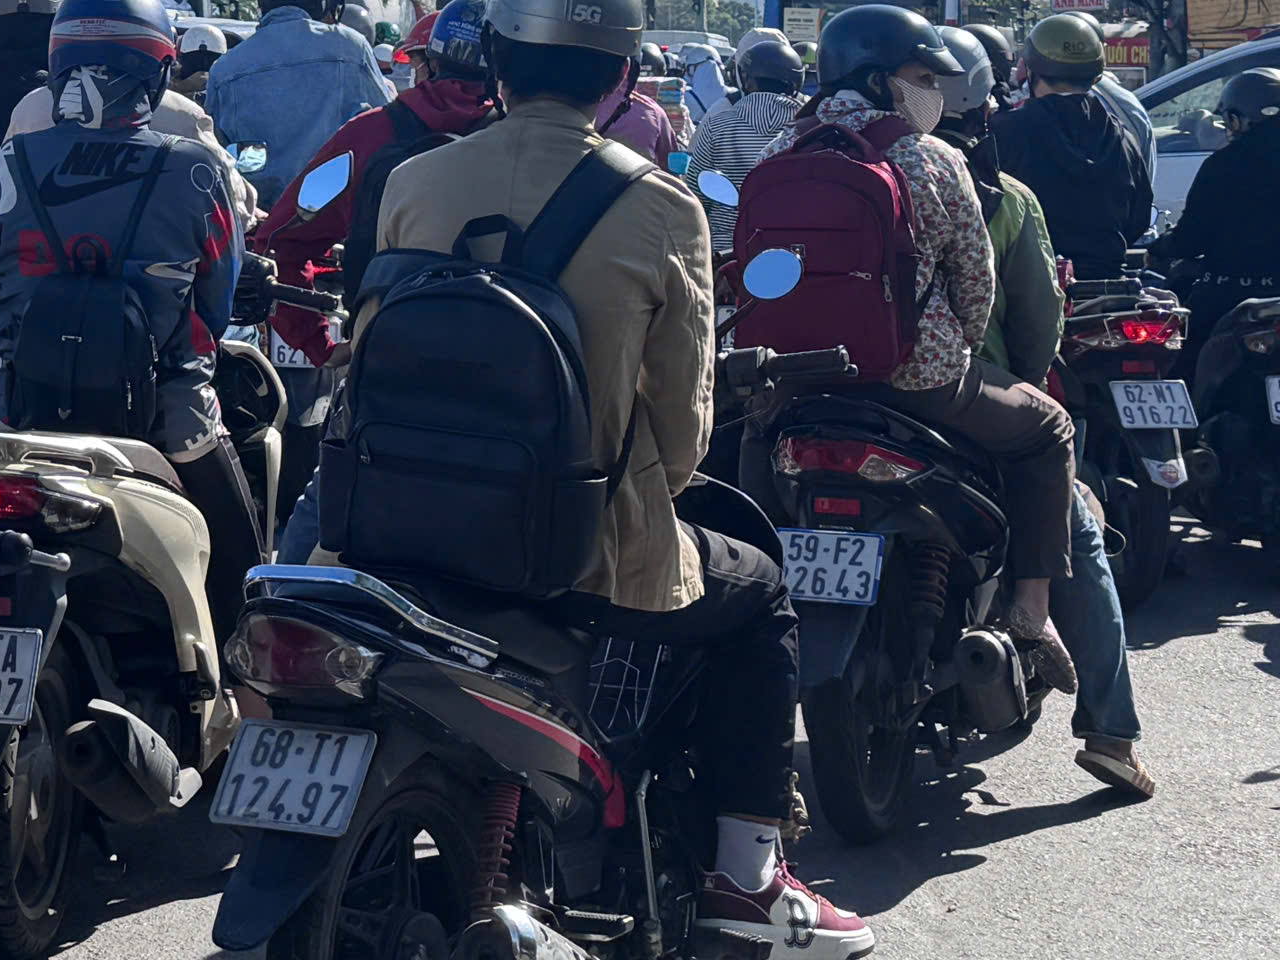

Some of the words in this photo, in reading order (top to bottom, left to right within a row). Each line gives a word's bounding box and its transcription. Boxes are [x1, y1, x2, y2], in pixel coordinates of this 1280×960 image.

[572, 4, 602, 24] 5G
[57, 142, 152, 177] NIKE
[1123, 384, 1176, 404] 62-N1
[1122, 405, 1192, 425] 916.22
[787, 533, 866, 567] 59-F2
[784, 565, 872, 600] 26.43
[250, 727, 349, 777] 68-T1
[226, 773, 350, 826] 124.97
